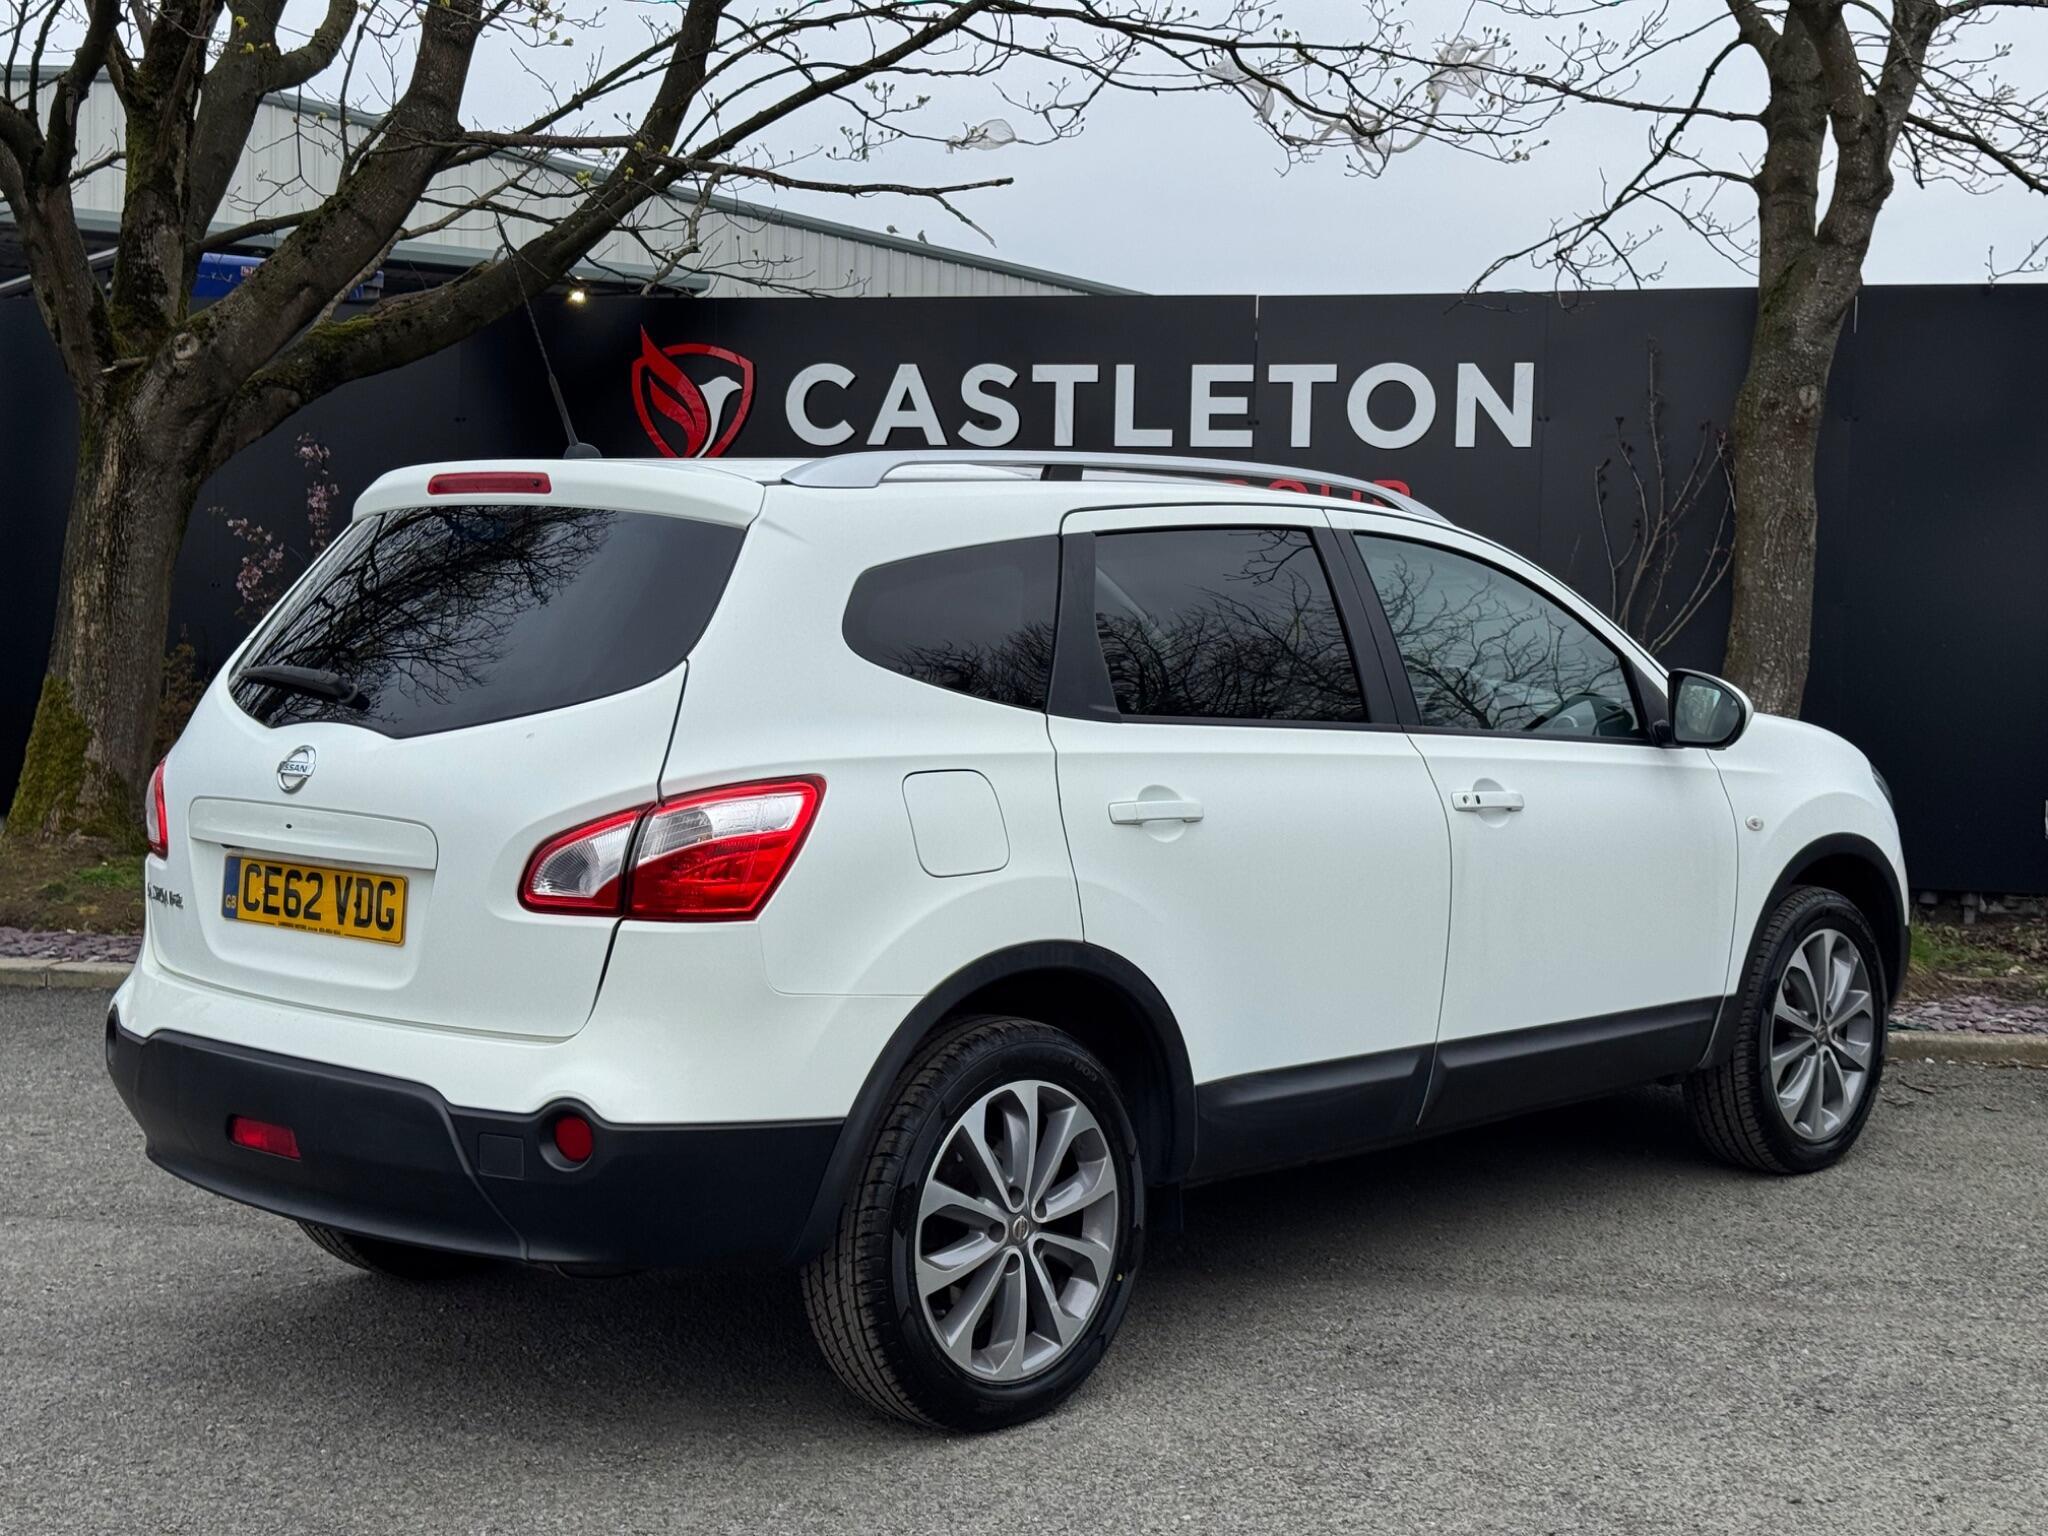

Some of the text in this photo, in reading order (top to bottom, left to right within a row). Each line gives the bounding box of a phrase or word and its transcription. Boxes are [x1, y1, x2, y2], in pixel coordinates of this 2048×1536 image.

[785, 362, 1535, 449] CASTLETON
[243, 863, 323, 921] CE62
[335, 874, 396, 932] VDG
